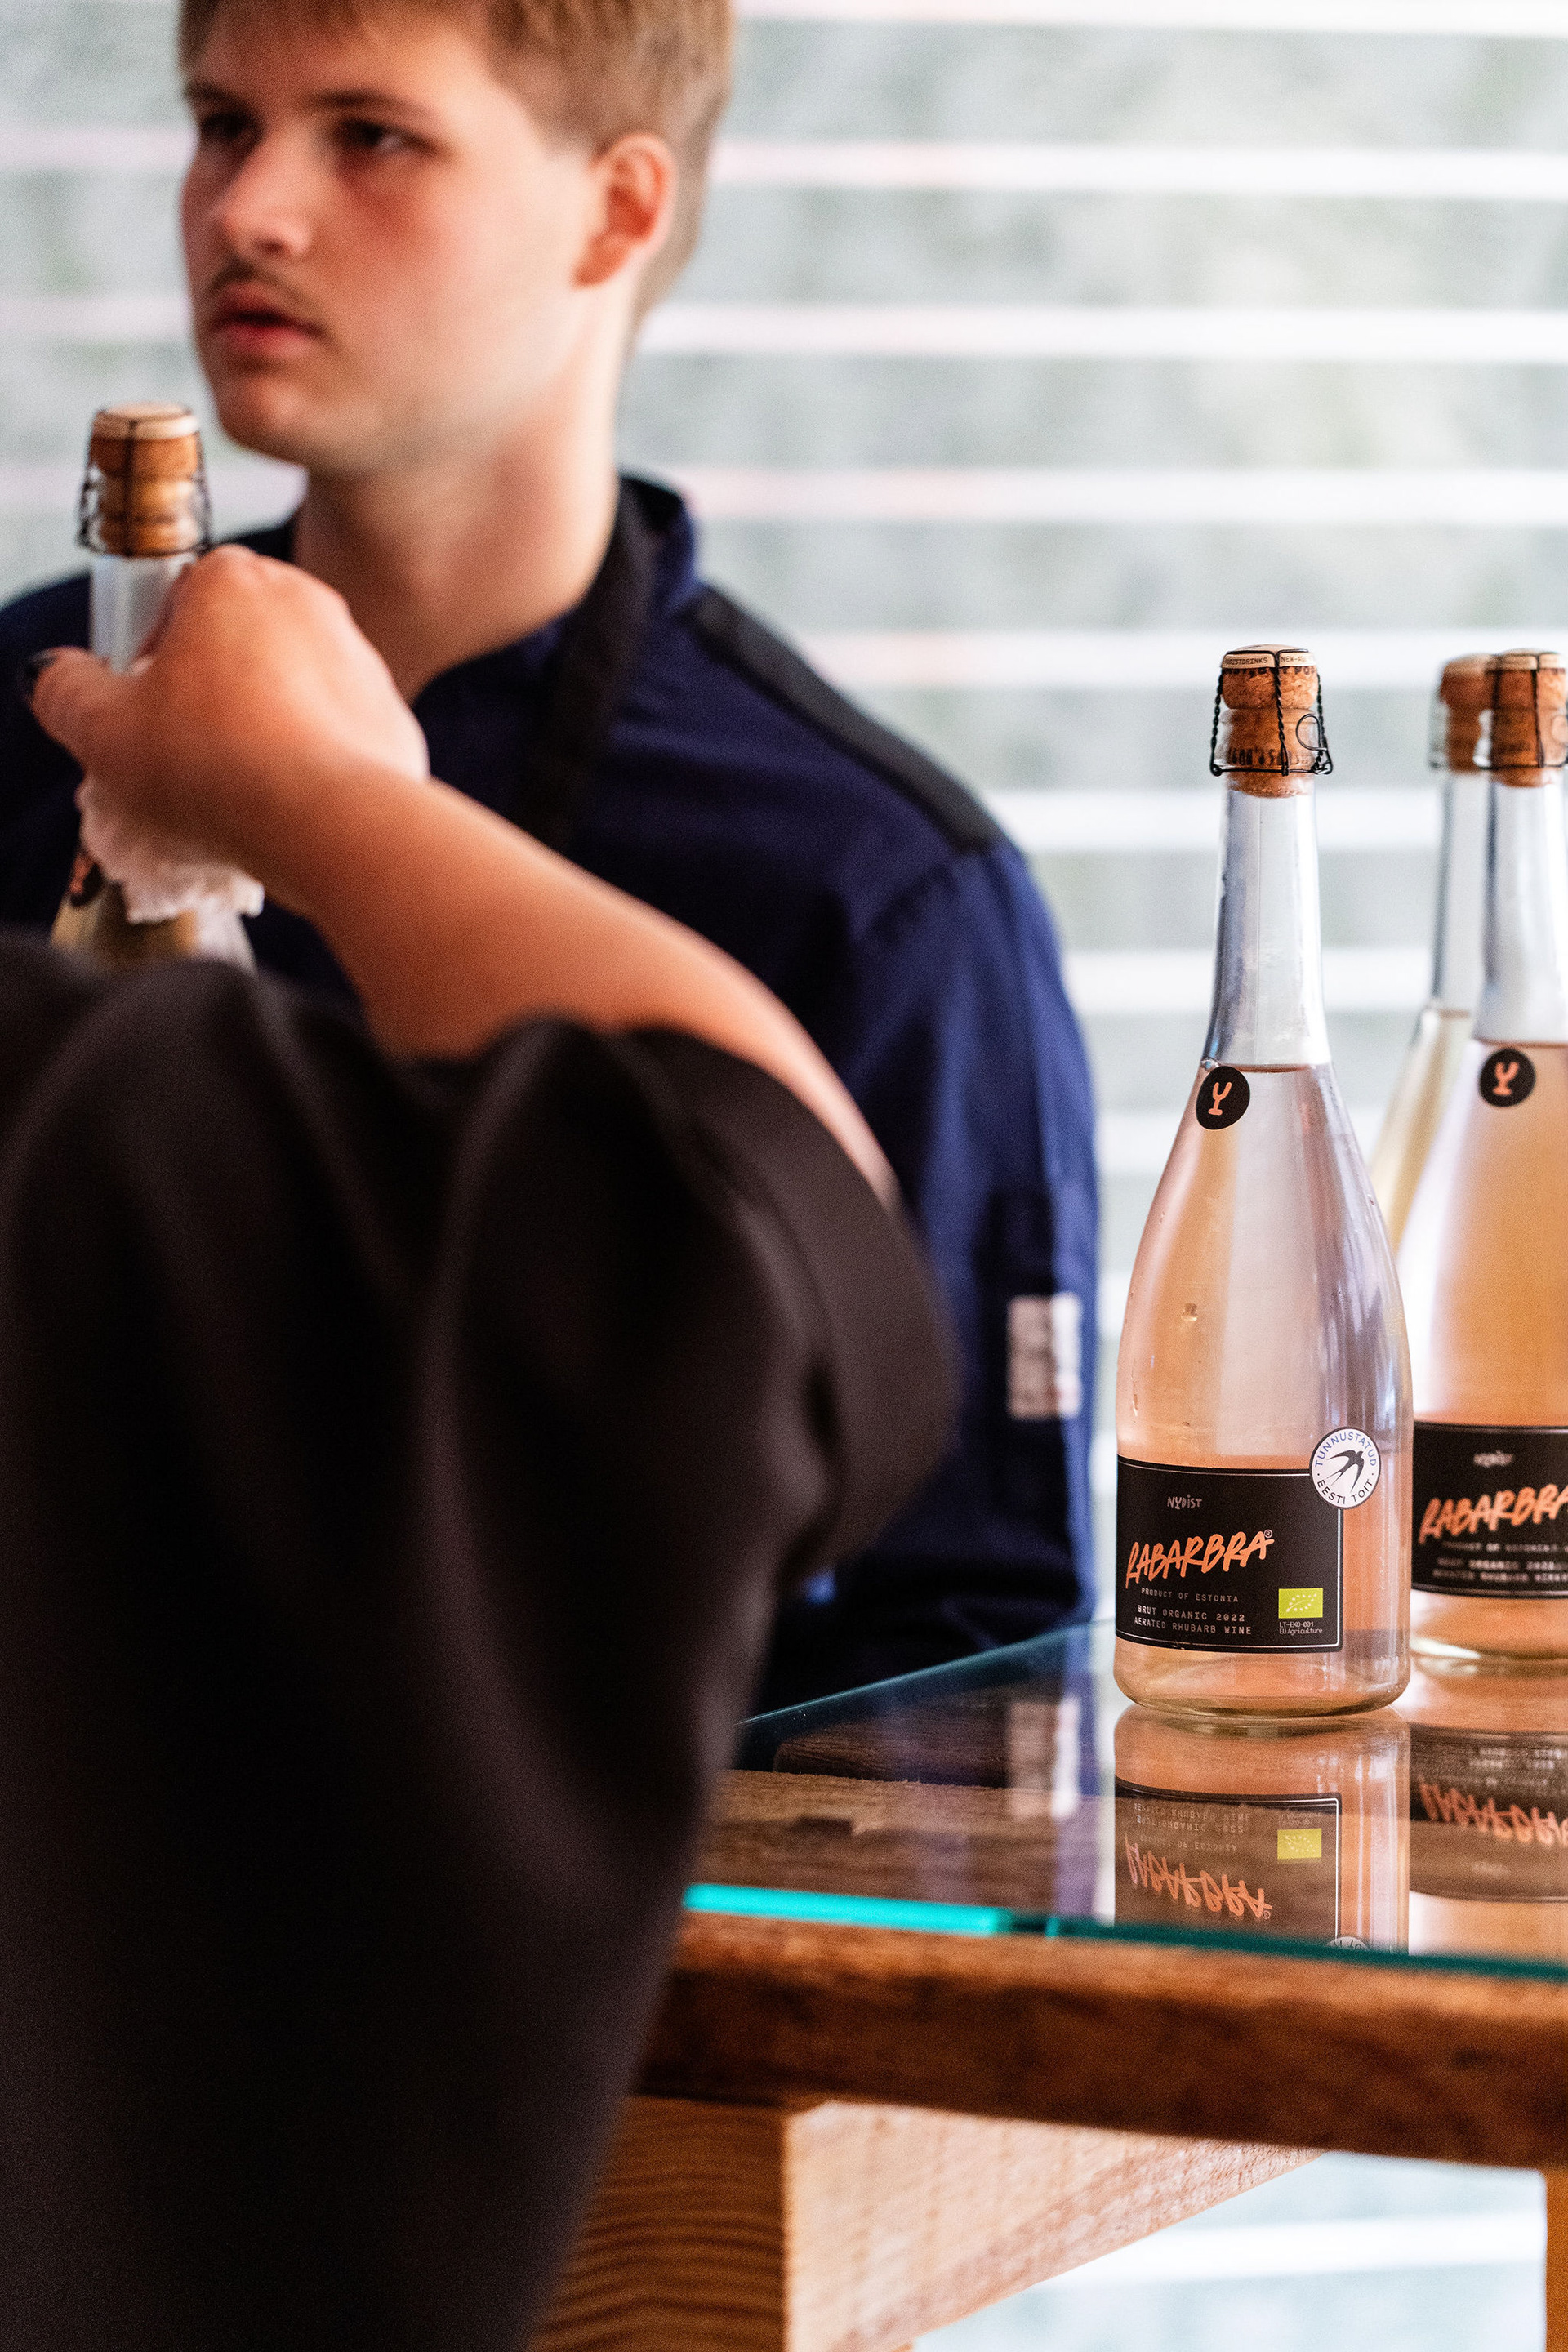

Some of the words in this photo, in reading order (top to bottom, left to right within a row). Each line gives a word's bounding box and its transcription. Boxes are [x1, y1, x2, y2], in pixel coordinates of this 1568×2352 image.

[1315, 1432, 1377, 1468] TUNNUSTATUD
[1317, 1479, 1346, 1504] EESTI
[1352, 1478, 1373, 1503] TOIT
[1141, 1587, 1173, 1599] PRODUCT
[1178, 1592, 1189, 1600] OF
[1195, 1593, 1239, 1603] ESTONIA
[1137, 1604, 1157, 1615] BRUT
[1162, 1607, 1208, 1621] ORGANIC
[1215, 1613, 1245, 1622] 2022
[1134, 1615, 1166, 1629] AERATED
[1172, 1621, 1217, 1633] RHUBARB
[1224, 1625, 1253, 1635] WINE
[1287, 1627, 1323, 1637] Agriculture
